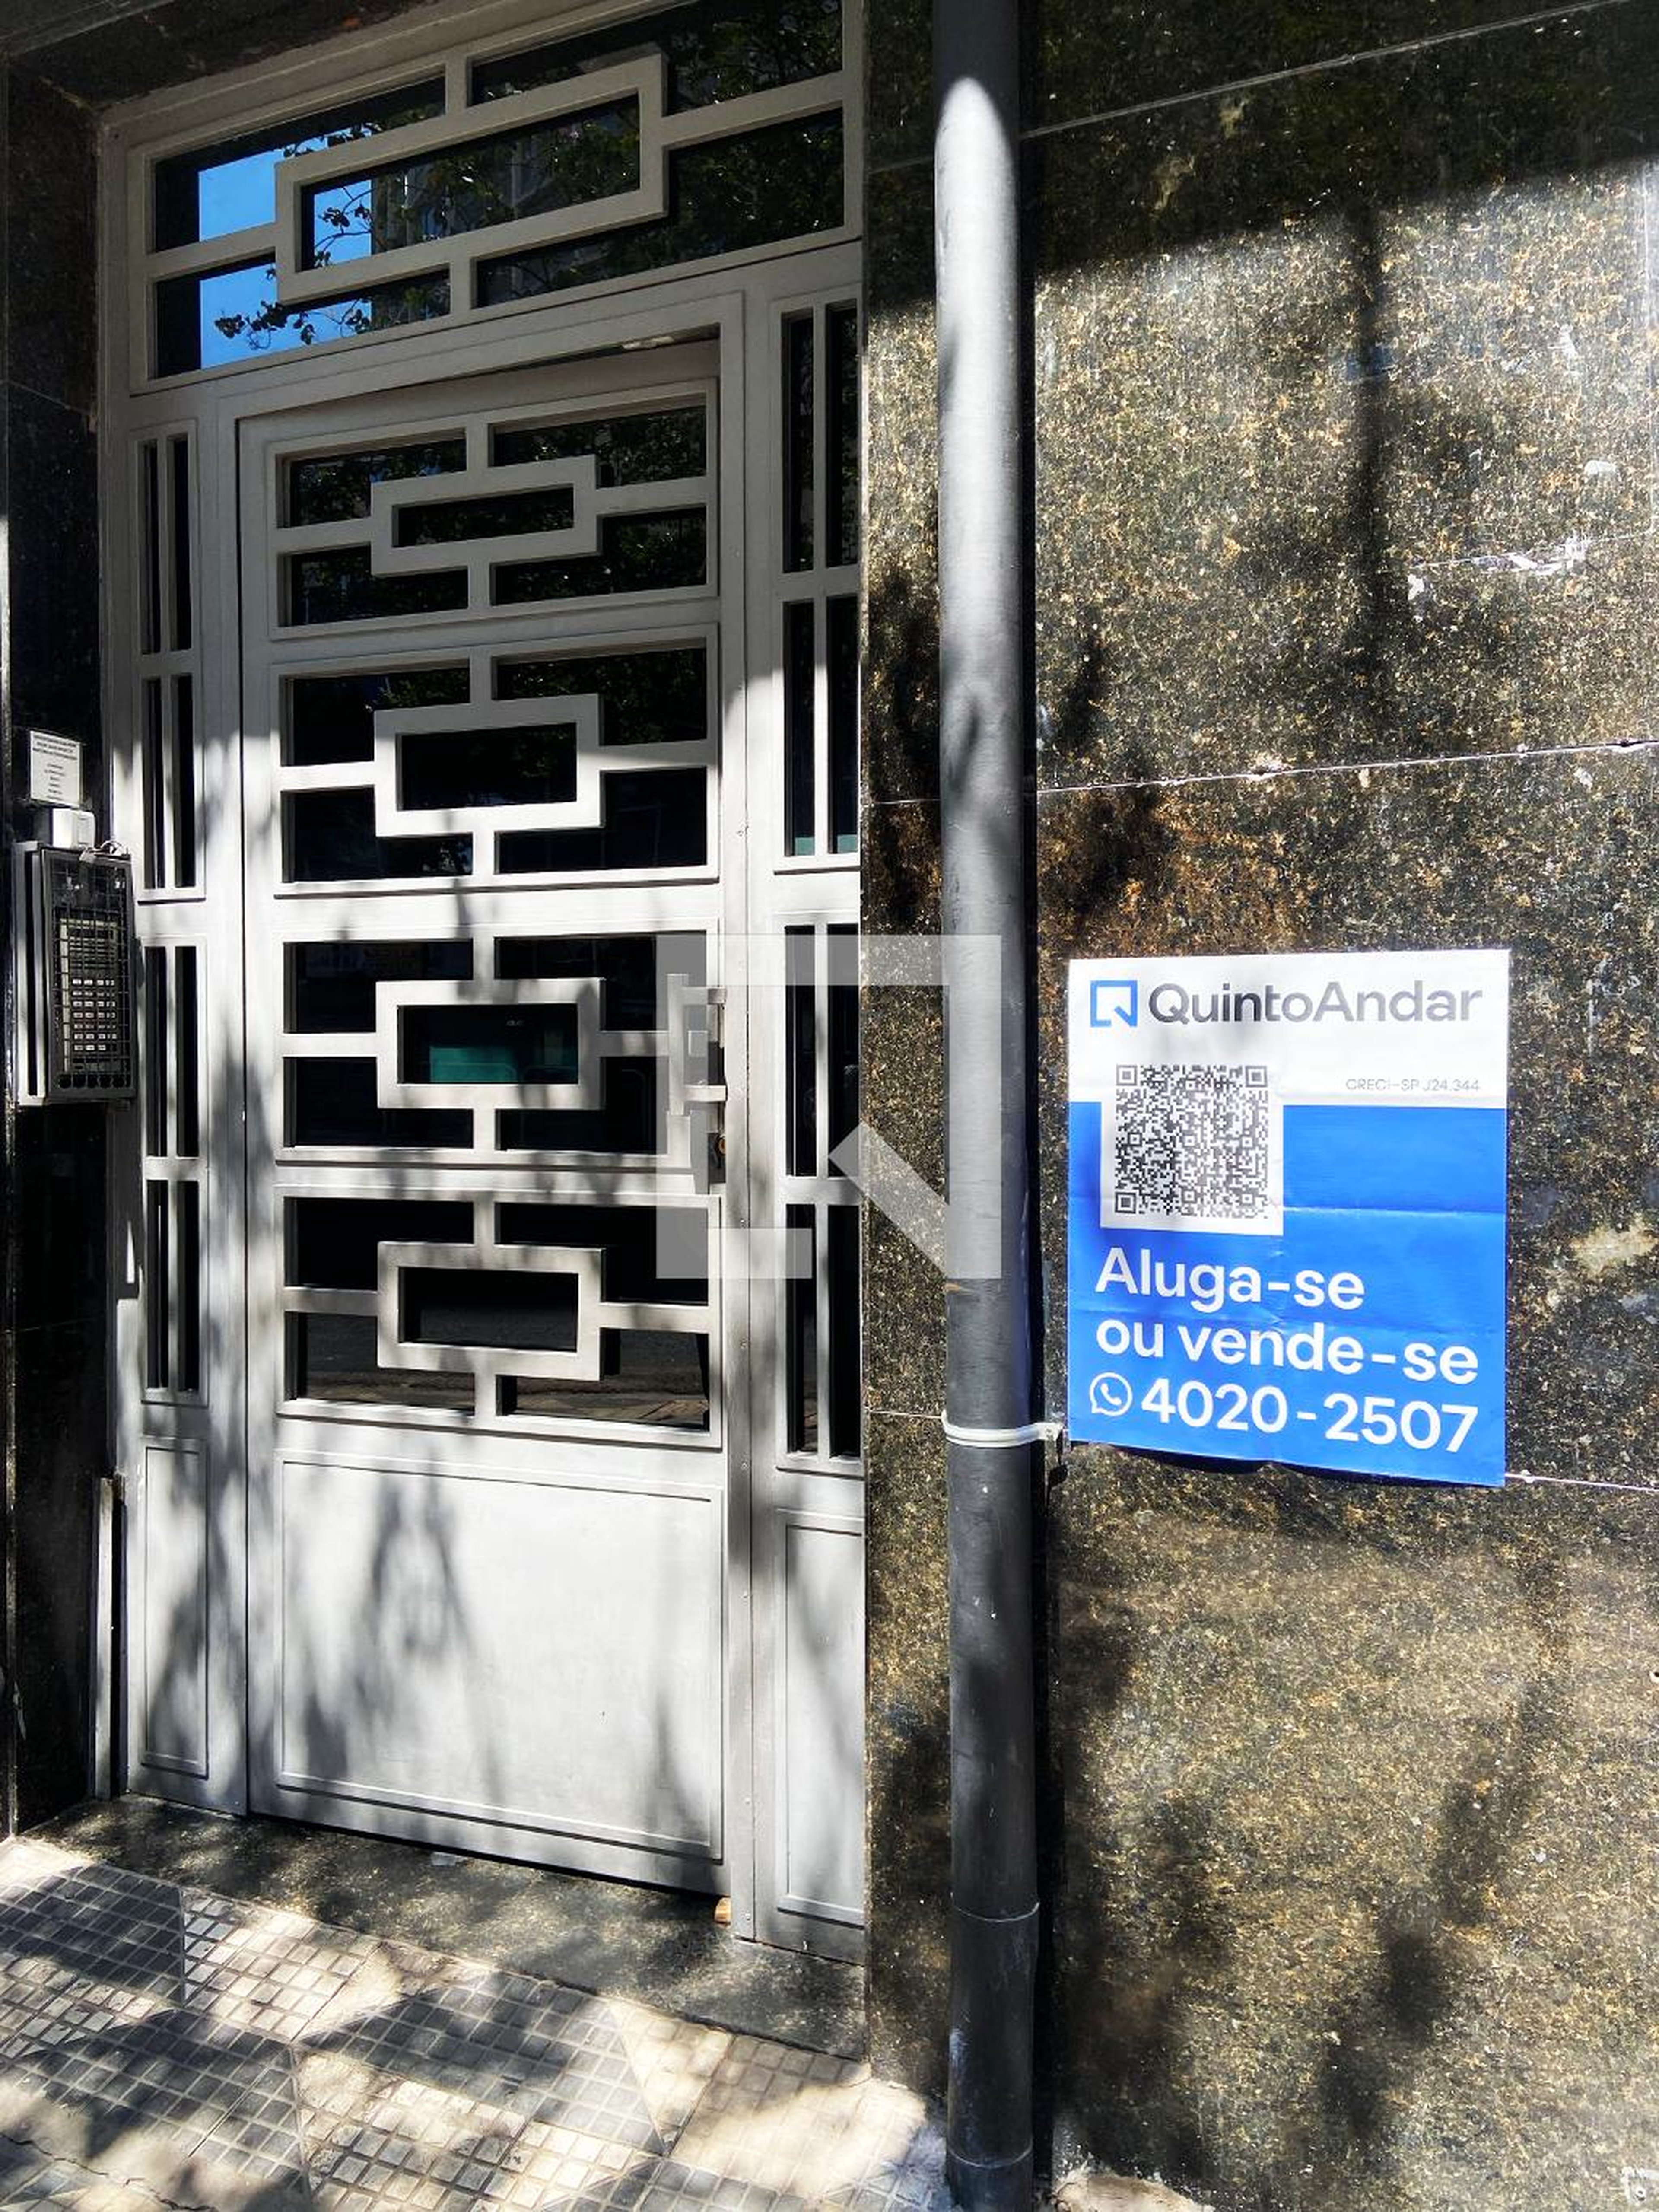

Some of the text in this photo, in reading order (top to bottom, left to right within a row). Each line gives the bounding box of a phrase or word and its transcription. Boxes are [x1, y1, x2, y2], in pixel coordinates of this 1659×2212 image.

[1148, 980, 1483, 1025] QuintoAndar
[1095, 1247, 1364, 1313] Aluga-se
[1096, 1318, 1478, 1384] ou vende-se
[1141, 1378, 1478, 1453] 4020-2507
